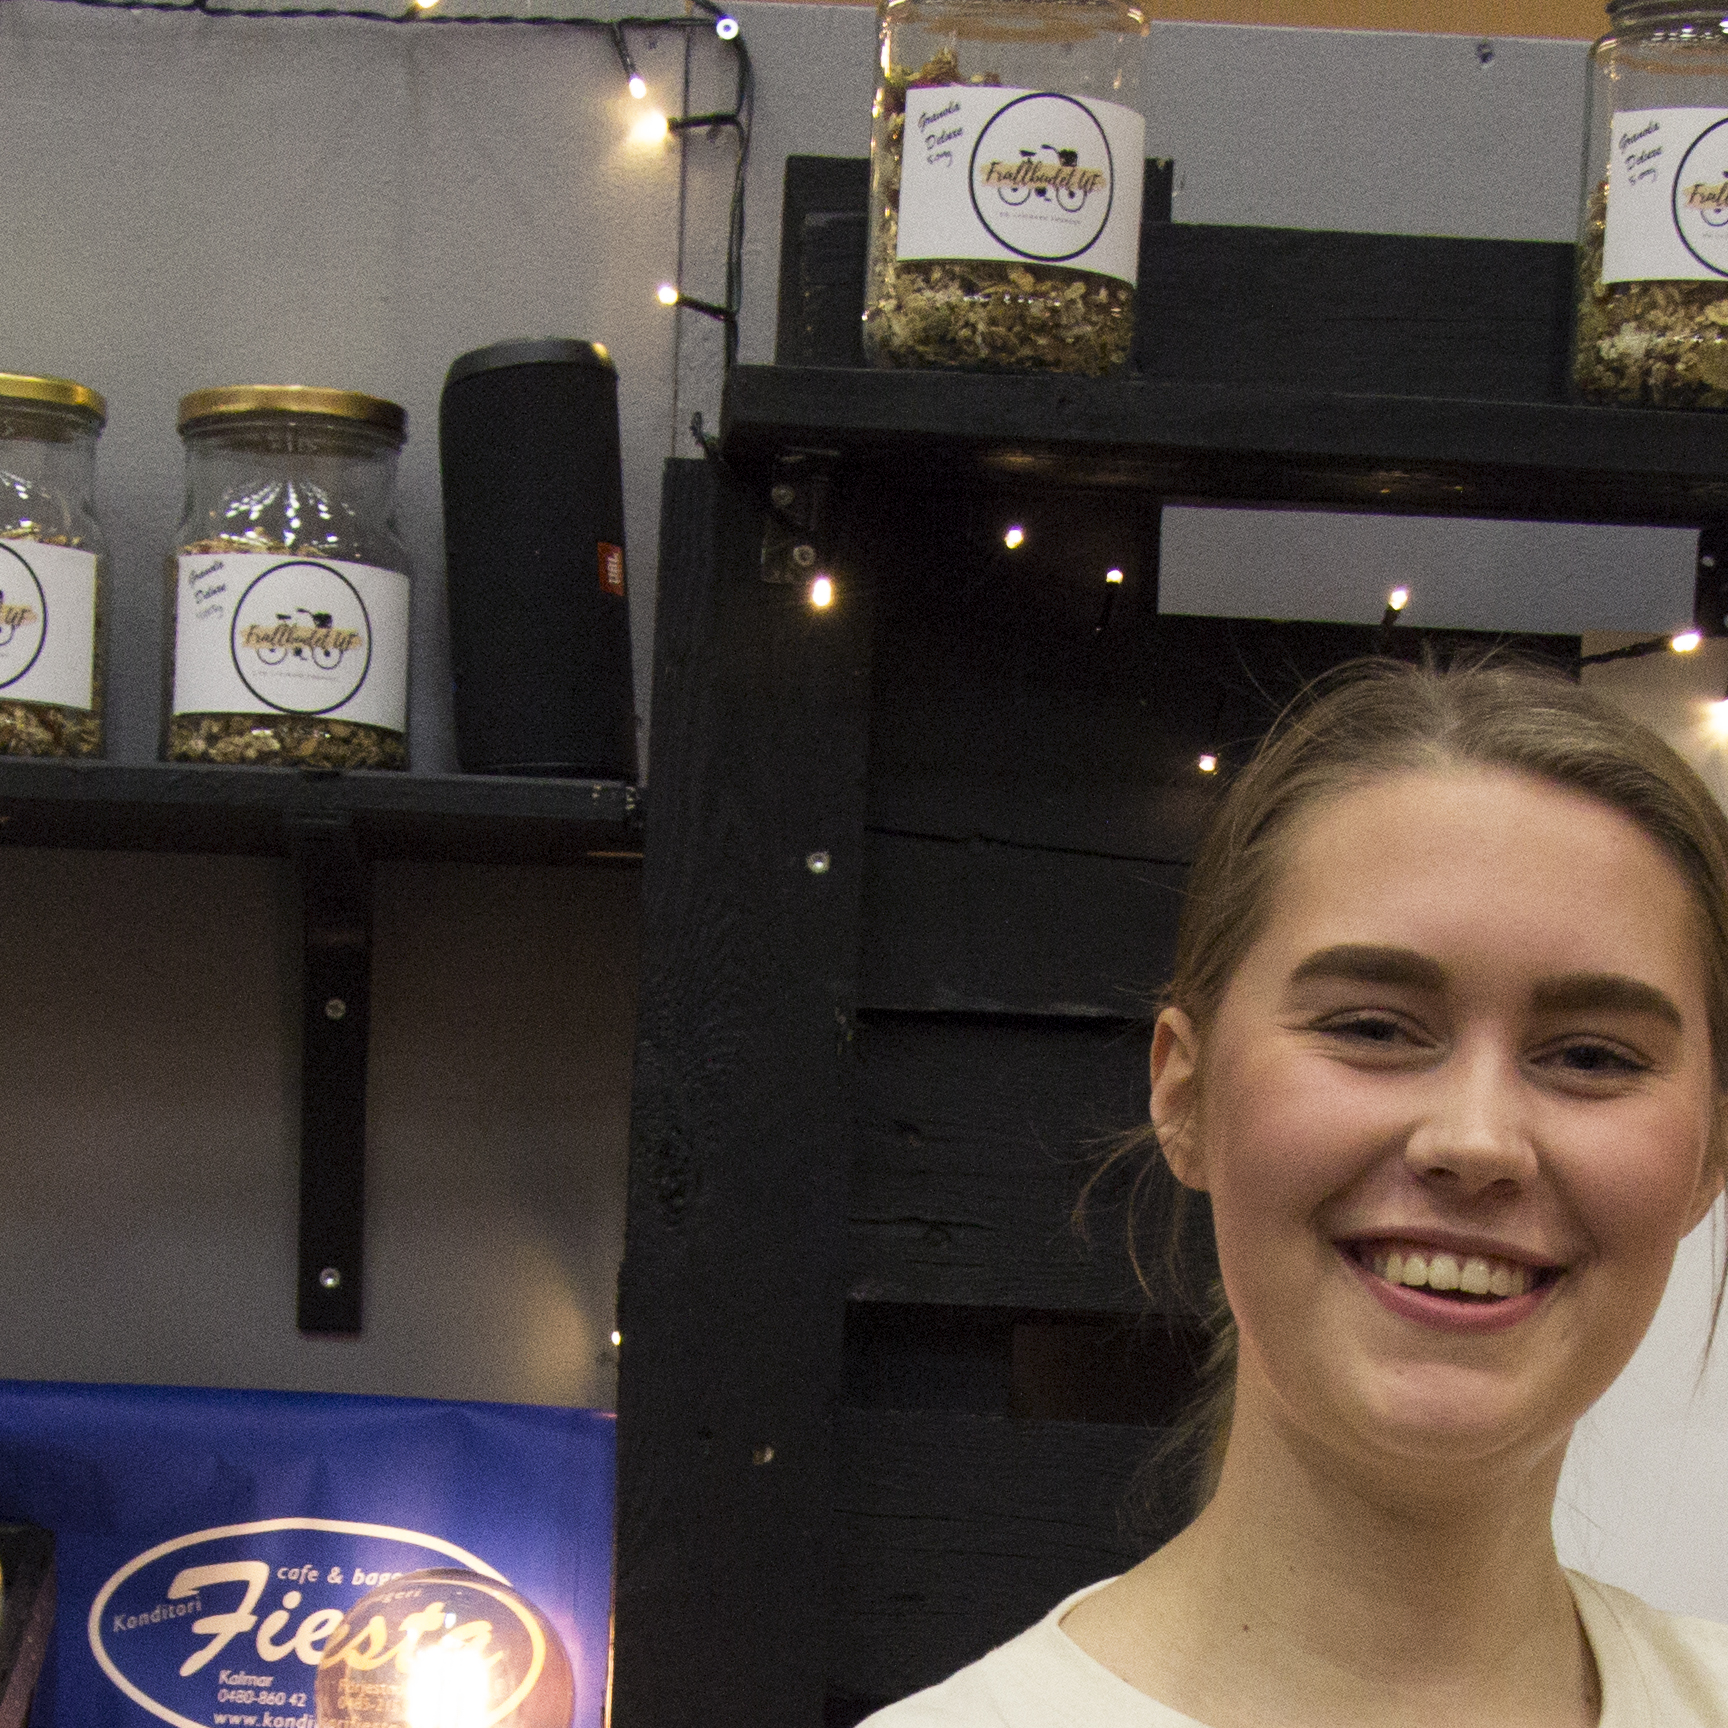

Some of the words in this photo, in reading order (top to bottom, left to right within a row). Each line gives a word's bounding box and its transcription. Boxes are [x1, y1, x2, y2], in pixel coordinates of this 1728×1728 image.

[277, 1564, 319, 1585] cafe
[327, 1566, 343, 1585] &
[113, 1598, 203, 1634] Konditori
[168, 1560, 504, 1678] Fiesta
[218, 1669, 274, 1687] Kalmar
[217, 1688, 286, 1706] 0480-860
[288, 1692, 308, 1708] 42
